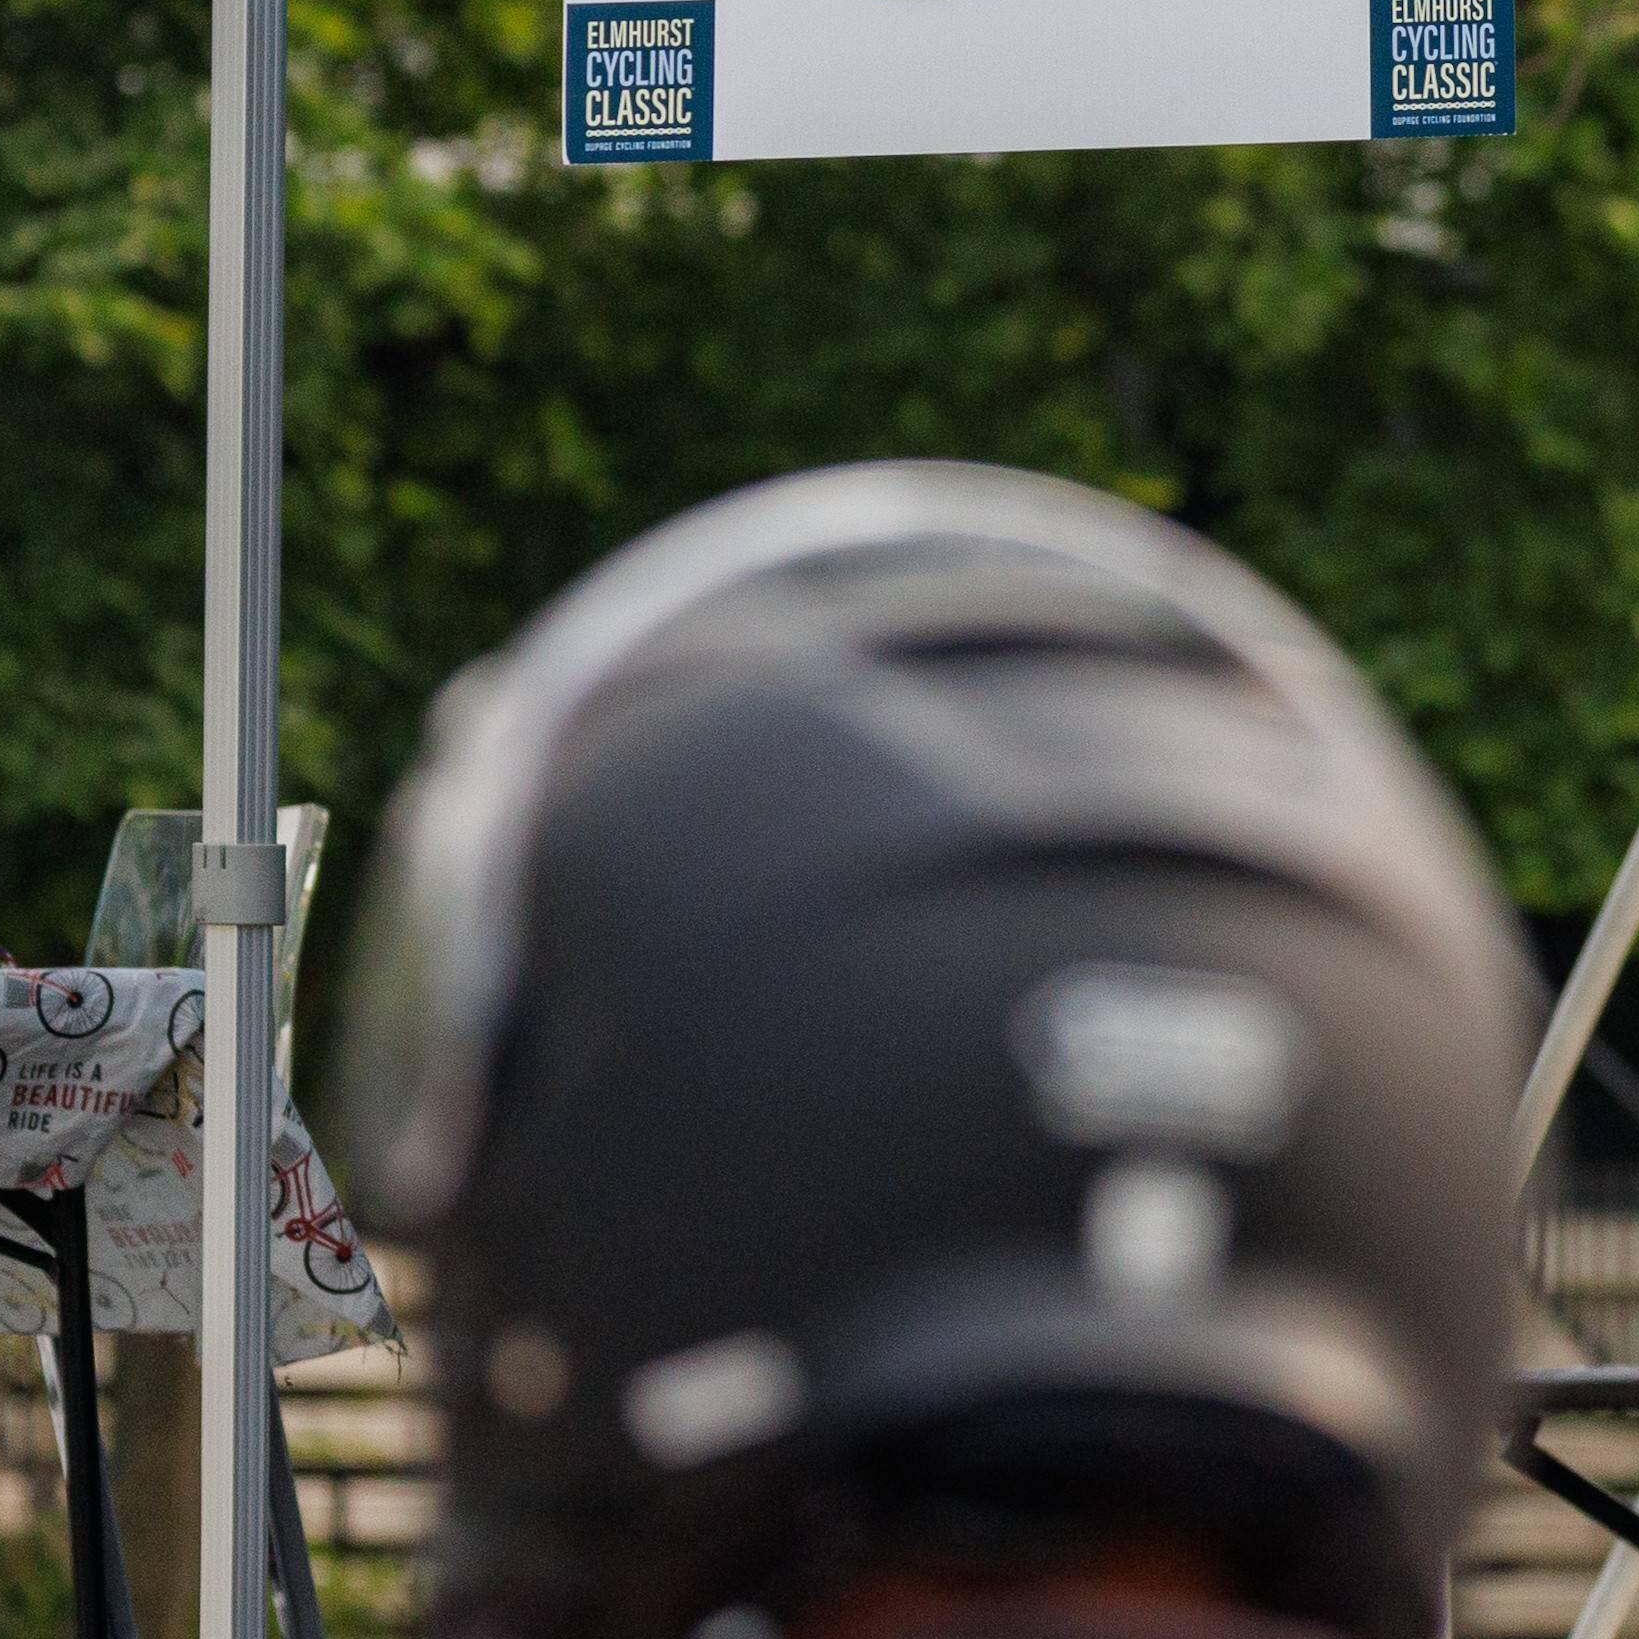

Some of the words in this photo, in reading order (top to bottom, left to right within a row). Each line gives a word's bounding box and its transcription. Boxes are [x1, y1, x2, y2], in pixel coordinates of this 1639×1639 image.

[587, 18, 694, 49] ELMHURST
[1391, 22, 1496, 62] CYCLING
[586, 48, 693, 88] CYCLING
[1392, 61, 1496, 101] CLASSIC
[585, 87, 692, 127] CLASSIC
[1422, 114, 1451, 125] CYCLING
[615, 140, 646, 151] CYCLING
[18, 1063, 56, 1081] LIFE
[64, 1062, 83, 1080] IS
[91, 1064, 103, 1082] A
[8, 1111, 52, 1133] RIDE
